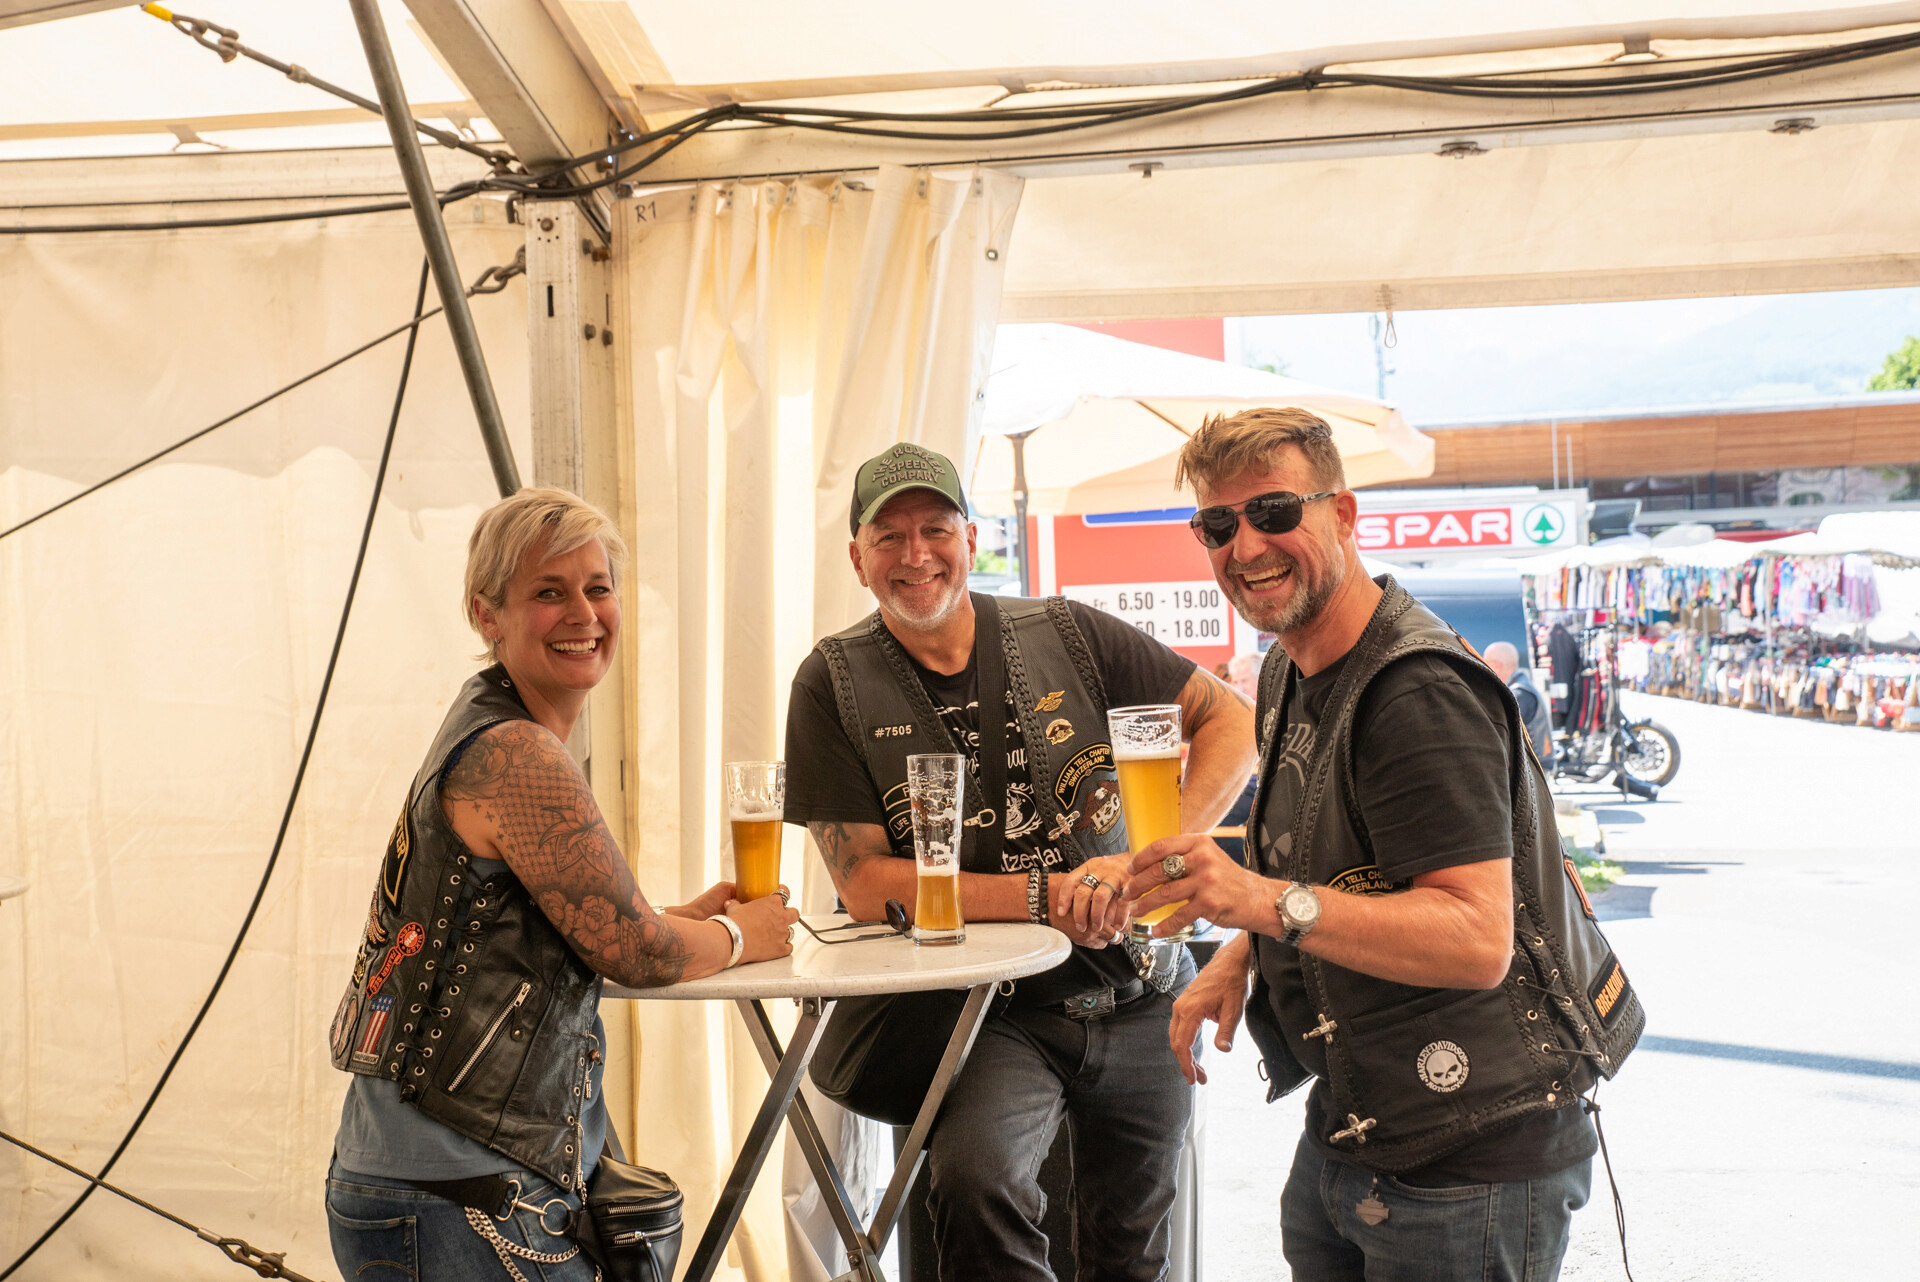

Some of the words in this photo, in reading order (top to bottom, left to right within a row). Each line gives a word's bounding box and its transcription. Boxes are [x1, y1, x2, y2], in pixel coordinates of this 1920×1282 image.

[635, 200, 656, 223] R1
[872, 458, 892, 482] THE
[889, 460, 928, 473] SPEED
[881, 470, 939, 487] COMPANY
[1357, 512, 1508, 547] SPAR
[1119, 592, 1154, 611] 6.50
[1174, 589, 1219, 609] 19.00
[1174, 619, 1220, 638] 18.00
[875, 724, 912, 738] #7505
[1058, 766, 1076, 794] WILLIAM
[1074, 754, 1089, 768] TELL
[1089, 748, 1110, 758] CHAPTER
[1068, 755, 1105, 787] SWITZERLAND
[894, 817, 910, 831] LIFE
[1345, 873, 1366, 885] TELL
